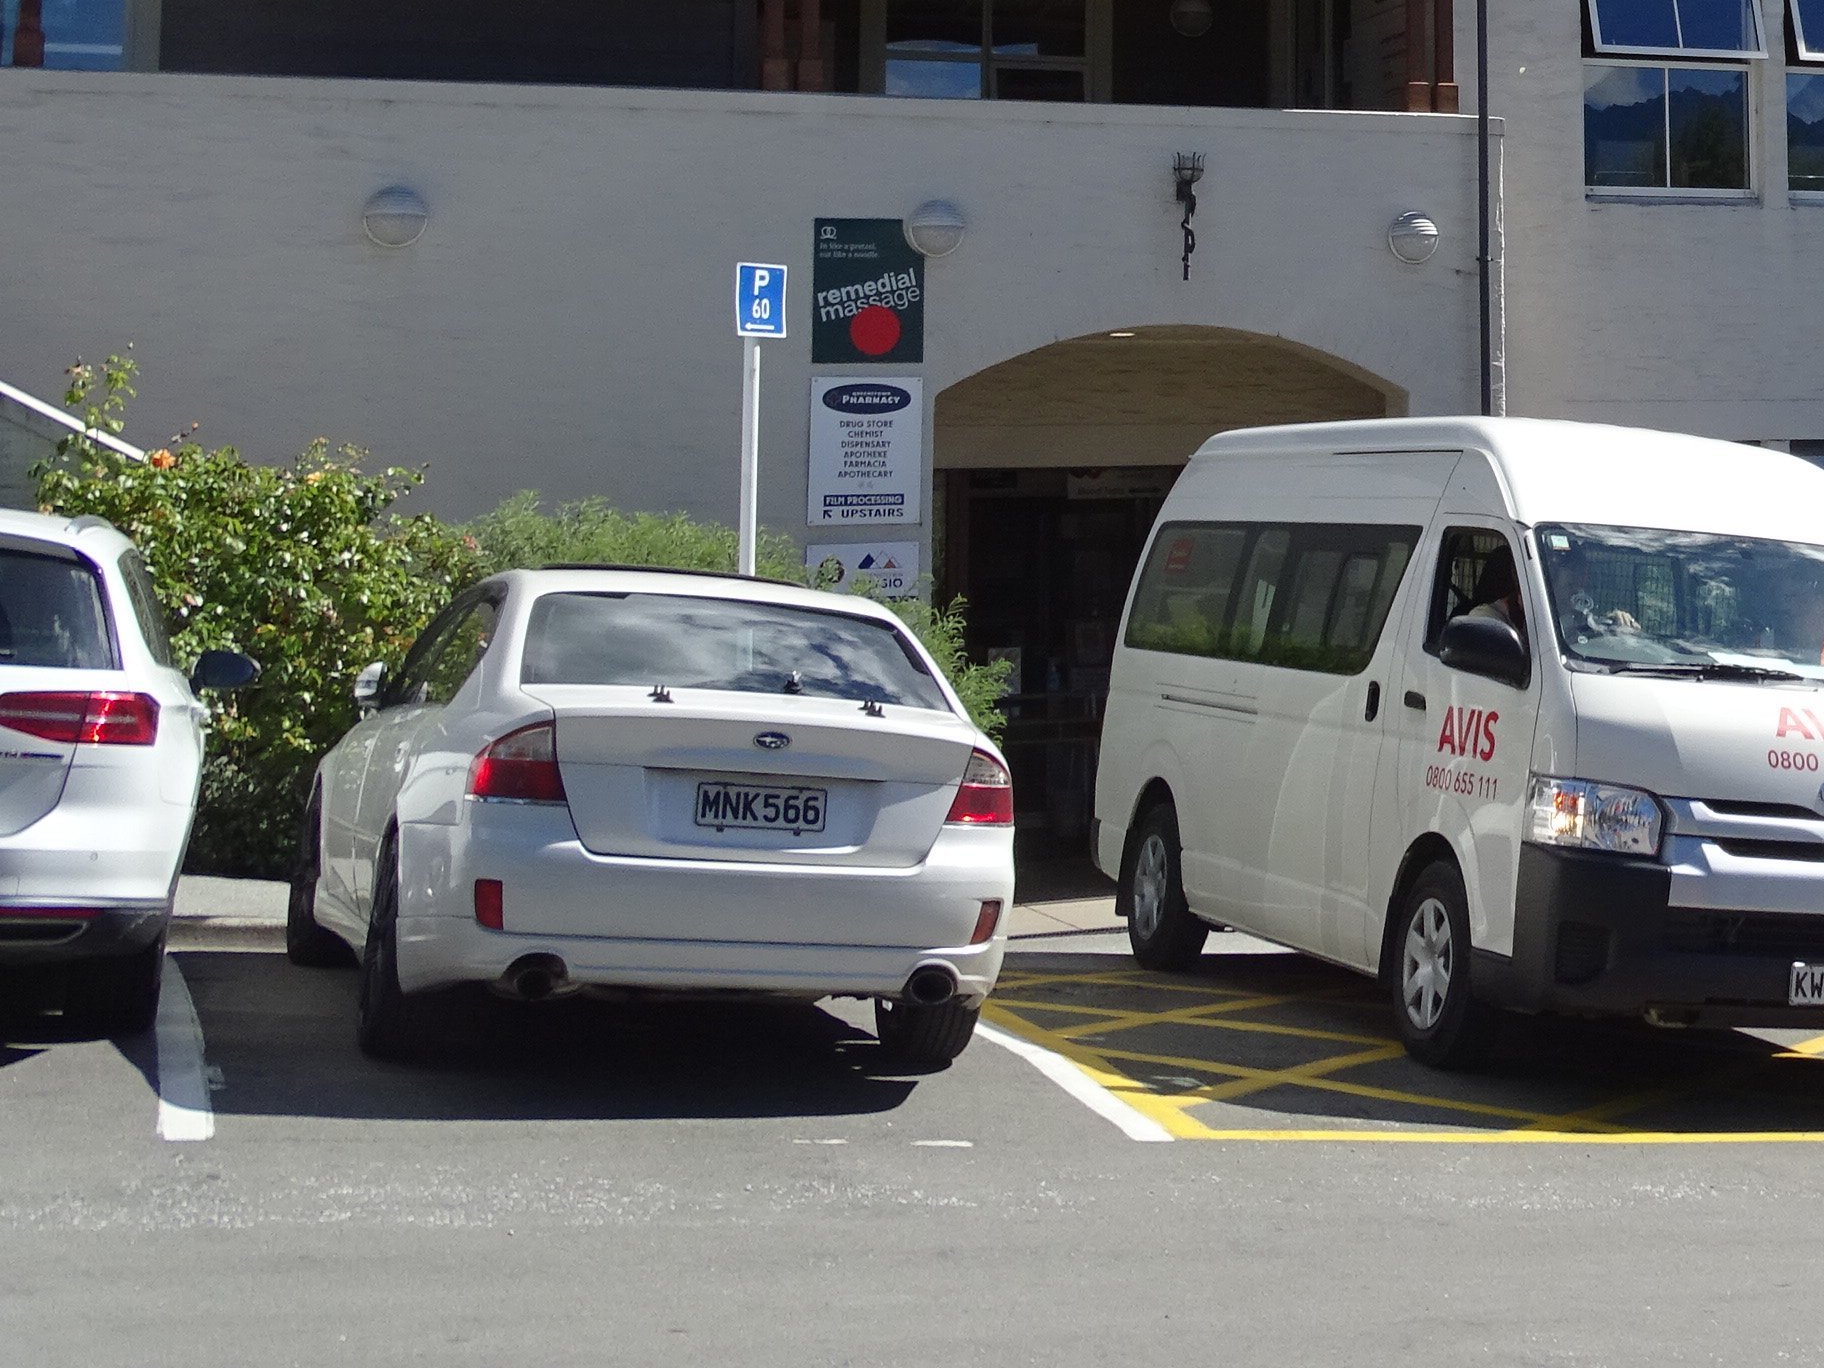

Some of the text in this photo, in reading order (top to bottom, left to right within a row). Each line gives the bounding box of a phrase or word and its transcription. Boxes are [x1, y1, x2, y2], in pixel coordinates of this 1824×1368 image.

[753, 268, 770, 296] P
[817, 267, 917, 307] remedial
[752, 298, 770, 320] 60
[820, 286, 920, 322] massage
[839, 420, 894, 429] DRUG STORE
[847, 430, 884, 439] CHEMIST
[840, 440, 891, 449] DISPENSARY
[843, 450, 888, 459] APOTHEKE
[843, 460, 887, 468] FARMACIA
[837, 470, 894, 479] APOTHECARY
[825, 494, 902, 505] FILM PROCESSING
[841, 507, 904, 519] UPSTAIRS
[1437, 705, 1499, 762] AVIS
[1767, 749, 1819, 772] 0800
[1426, 765, 1498, 801] 0800 655 111
[700, 790, 820, 825] MNK566
